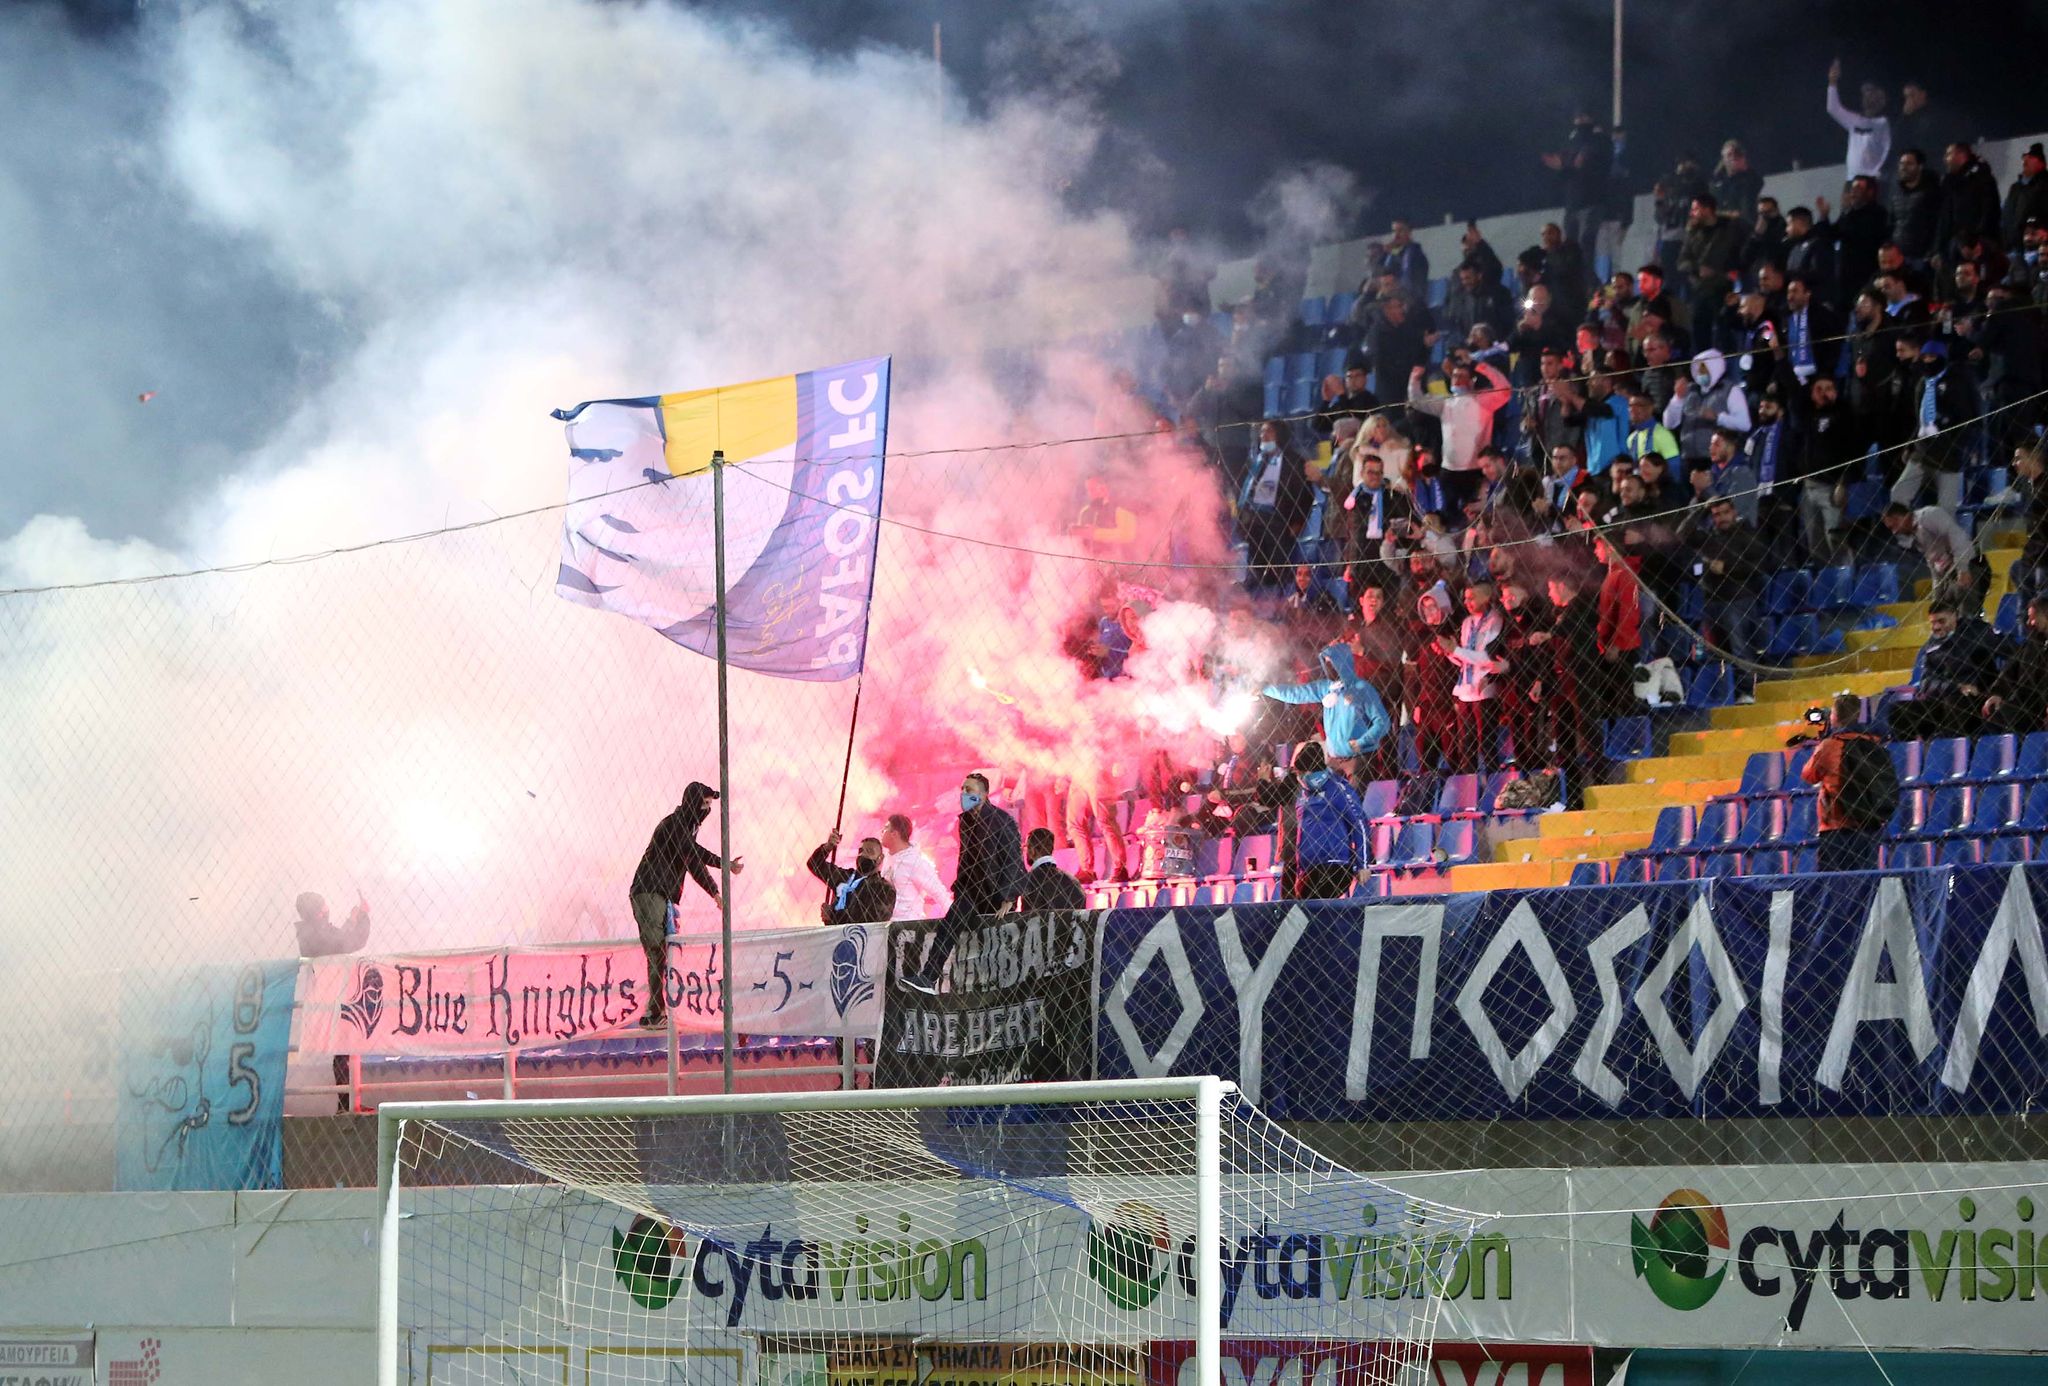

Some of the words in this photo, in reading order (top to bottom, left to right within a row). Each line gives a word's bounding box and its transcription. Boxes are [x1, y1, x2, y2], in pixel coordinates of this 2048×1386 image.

[392, 963, 467, 1037] Blue
[486, 953, 640, 1046] Knights
[897, 1008, 962, 1057] ARE
[693, 1211, 987, 1328] cytavision
[892, 1342, 1002, 1369] ΣΥΤΗΜΑΤΑ
